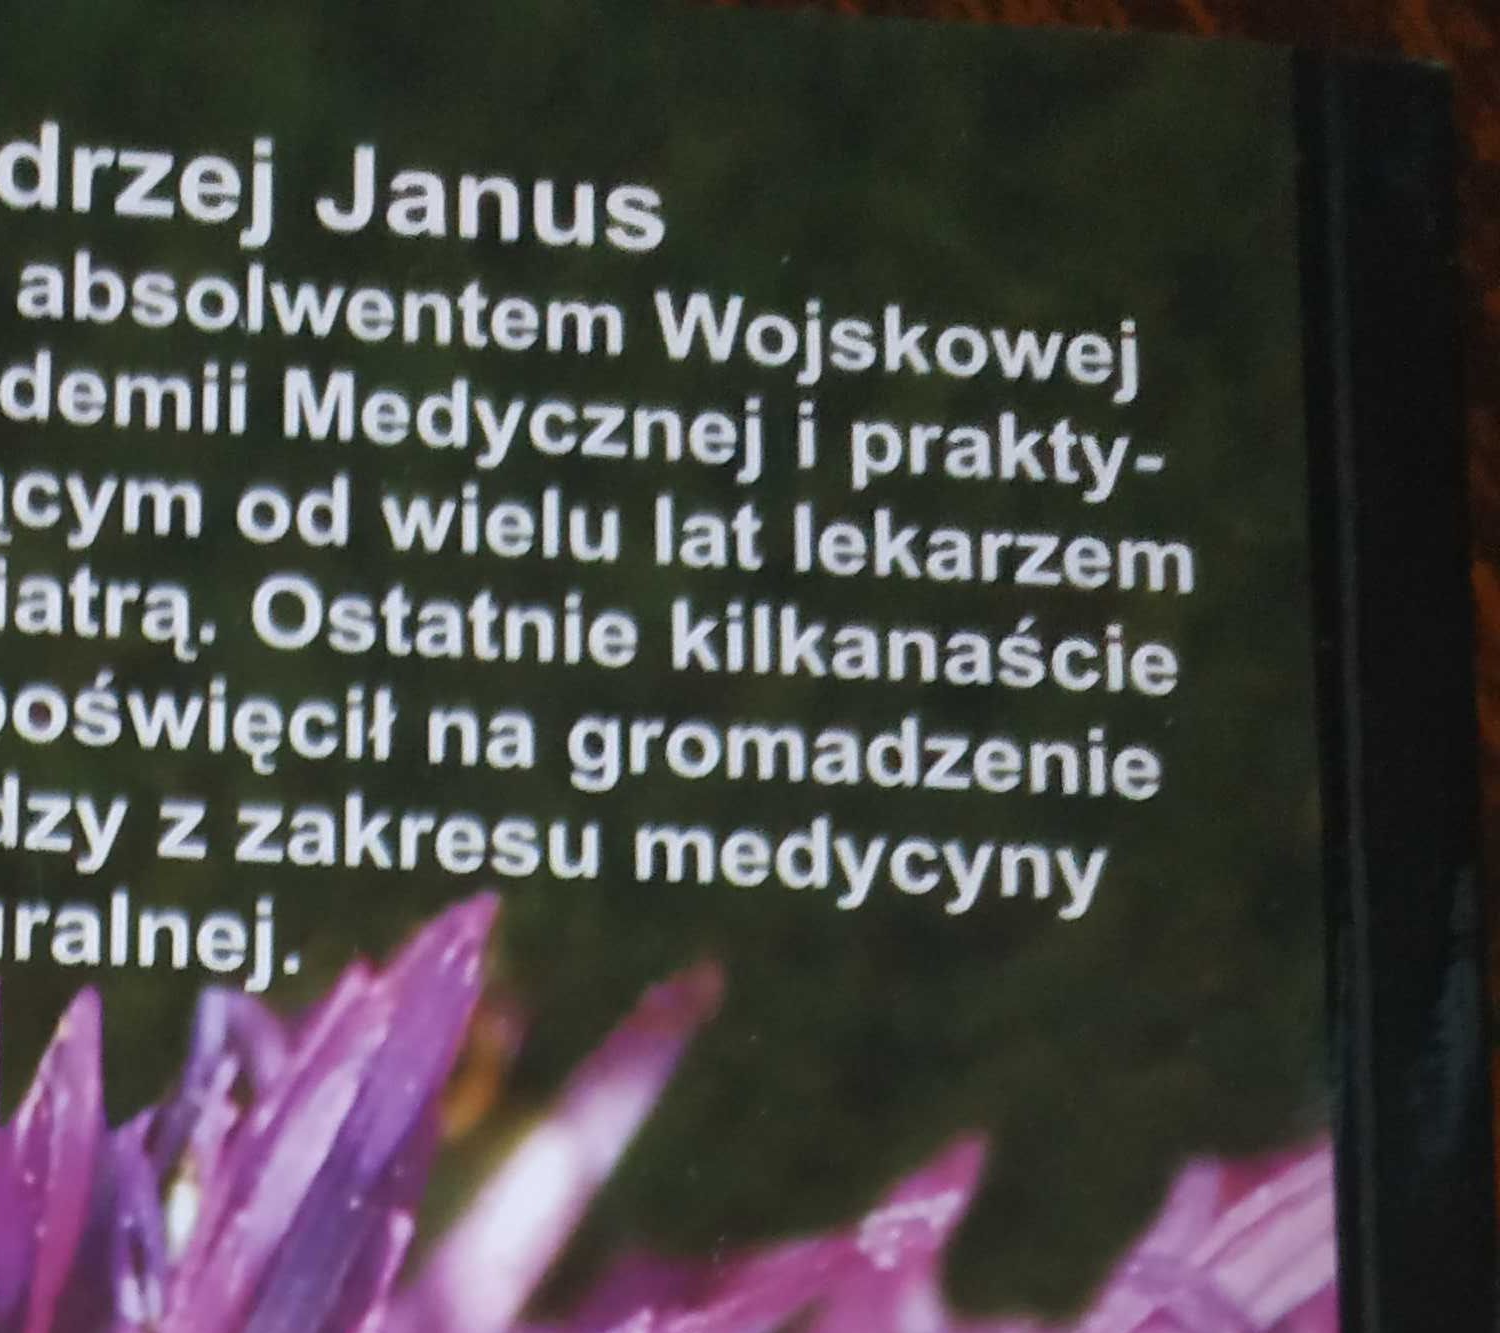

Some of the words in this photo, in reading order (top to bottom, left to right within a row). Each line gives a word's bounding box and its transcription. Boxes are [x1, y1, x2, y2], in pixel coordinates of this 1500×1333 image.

[316, 146, 664, 251] Janus
[18, 251, 622, 354] absolwentem
[655, 291, 1137, 403] Wojskowej
[284, 368, 761, 483] Medycznej
[799, 402, 815, 468] i
[852, 412, 1163, 502] prakty-
[237, 476, 348, 546] od
[382, 484, 618, 561] wielu
[656, 495, 762, 570] lat
[795, 504, 1193, 593] lekarzem
[253, 576, 637, 667] Ostatnie
[672, 599, 1177, 694] kilkanaście
[429, 710, 534, 768] na
[568, 718, 1159, 800] gromadzenie
[158, 803, 206, 859] z
[236, 793, 598, 878] zakresu
[636, 818, 1106, 919] medycyny
